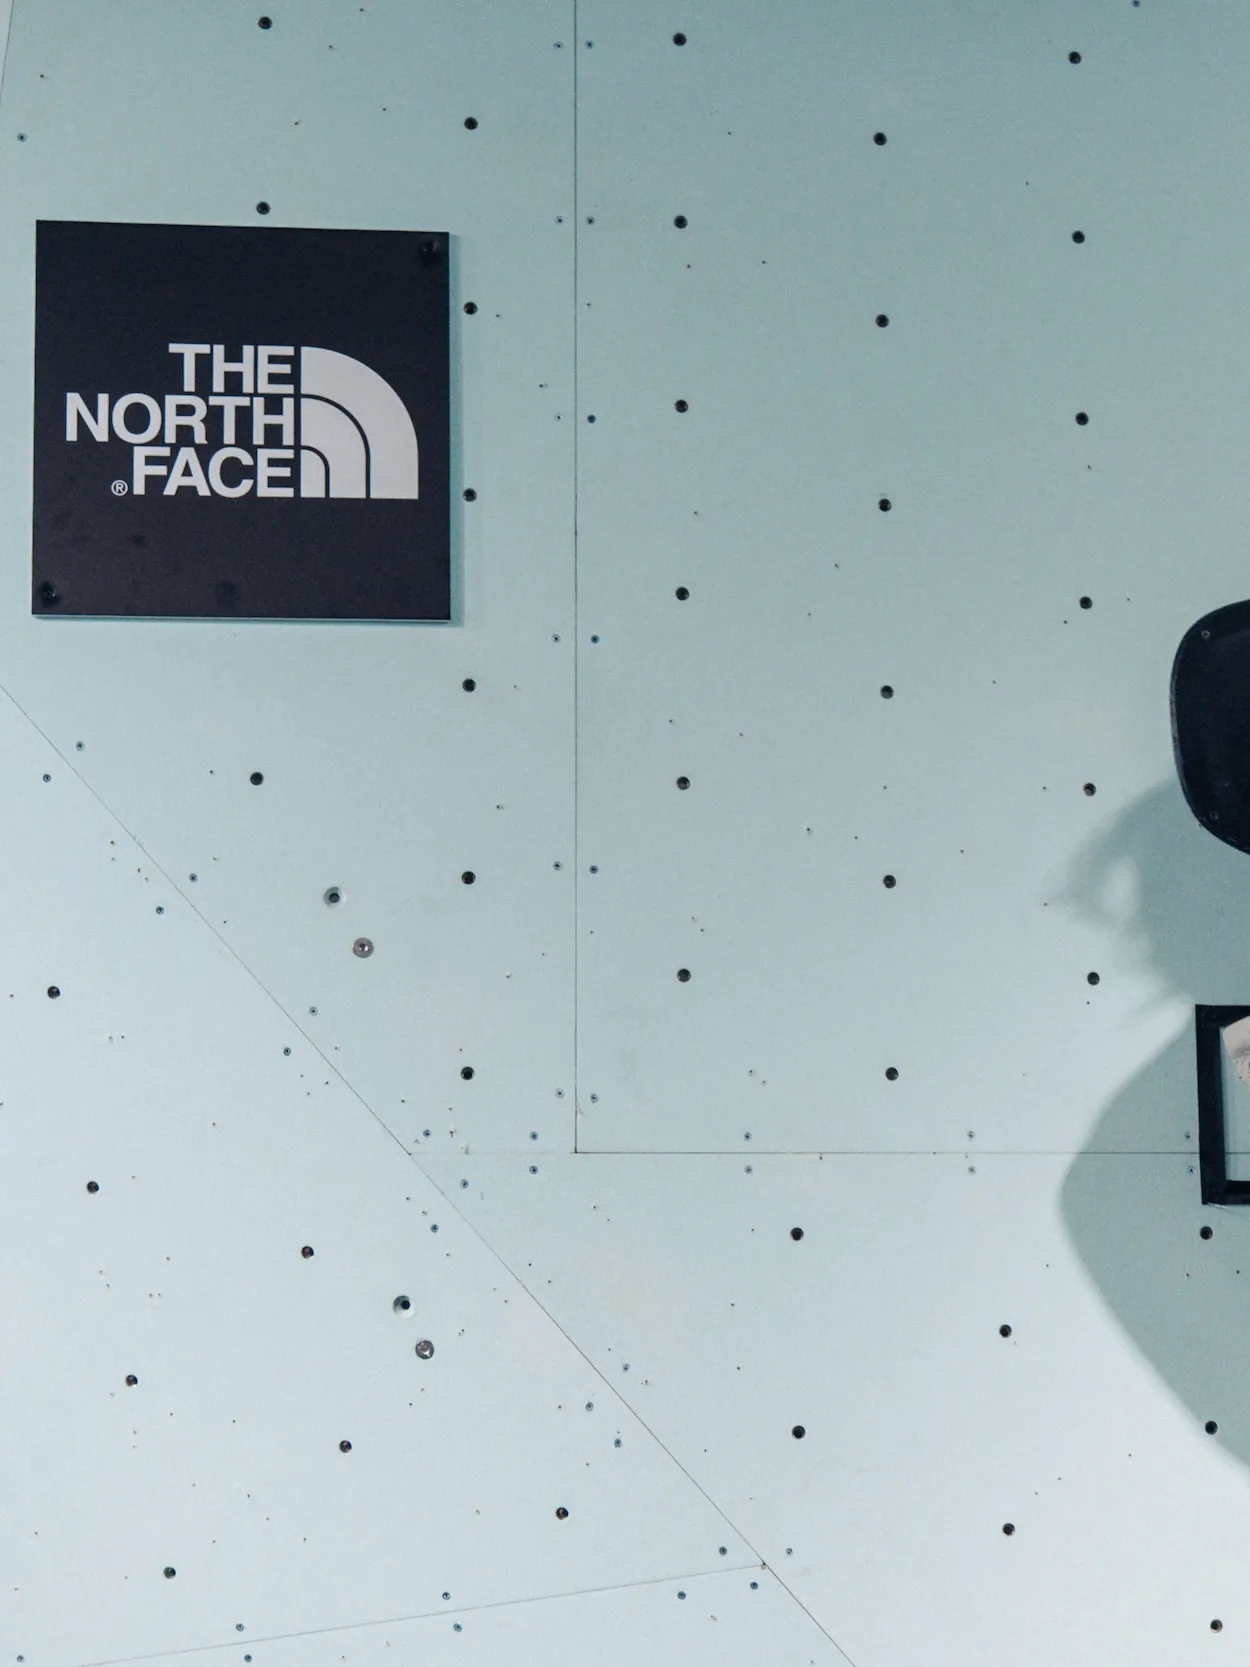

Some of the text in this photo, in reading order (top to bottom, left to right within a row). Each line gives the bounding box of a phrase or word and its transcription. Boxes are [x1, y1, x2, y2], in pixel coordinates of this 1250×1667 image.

[168, 343, 295, 394] THE
[65, 392, 295, 446] NORTH
[132, 446, 295, 498] FACE
